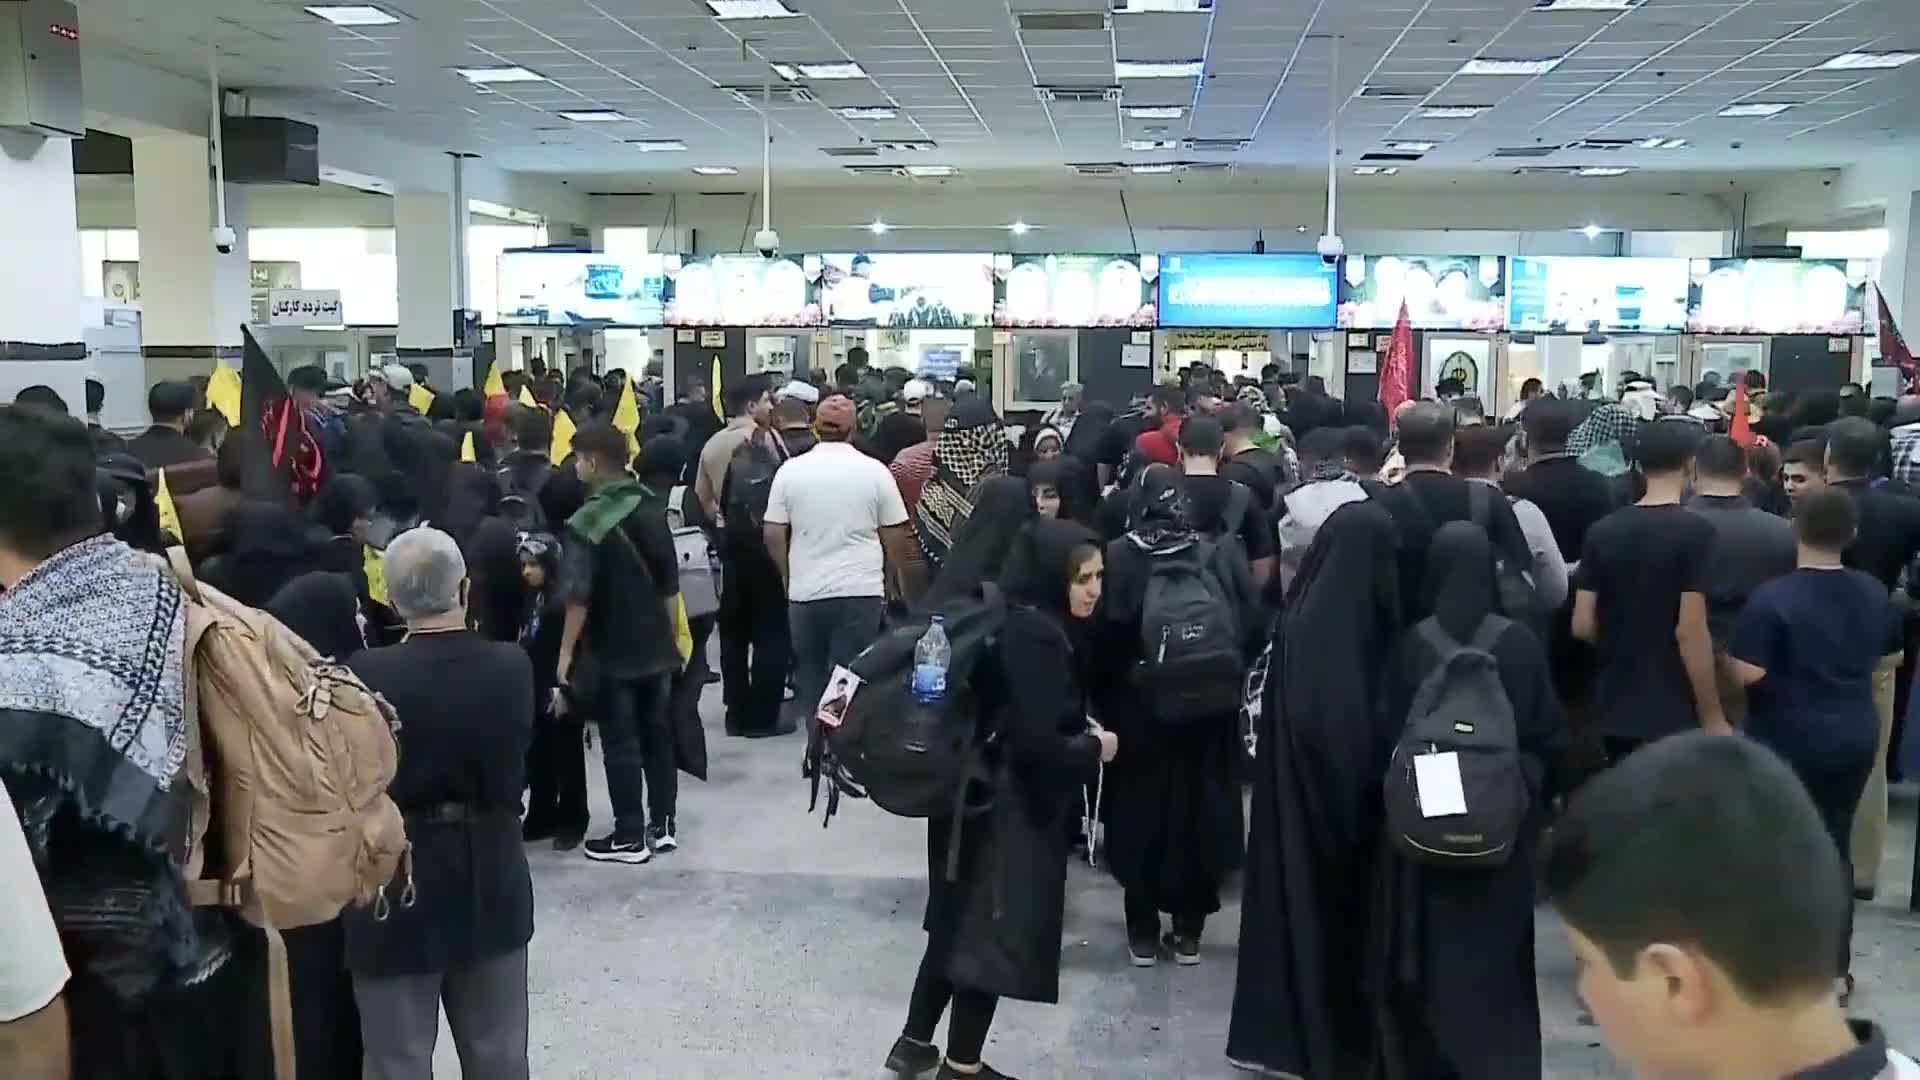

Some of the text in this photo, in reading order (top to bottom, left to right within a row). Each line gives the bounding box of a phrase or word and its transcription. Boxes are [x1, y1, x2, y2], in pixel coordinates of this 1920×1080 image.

[272, 299, 339, 316] گیت تردد کارکنان
